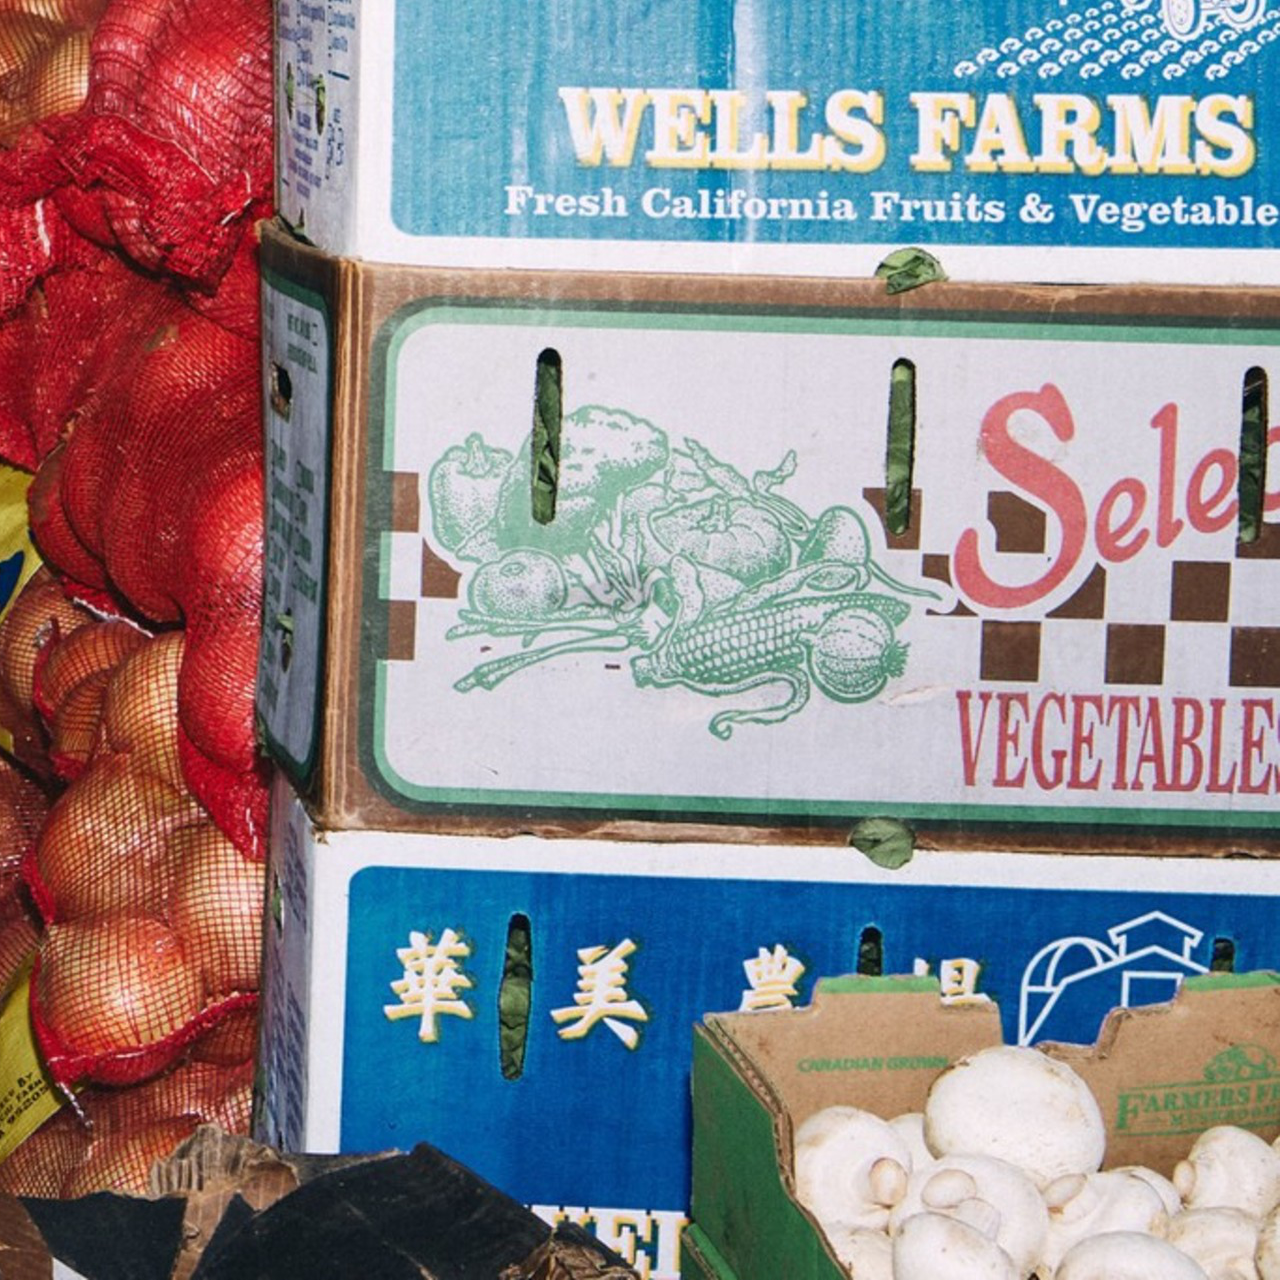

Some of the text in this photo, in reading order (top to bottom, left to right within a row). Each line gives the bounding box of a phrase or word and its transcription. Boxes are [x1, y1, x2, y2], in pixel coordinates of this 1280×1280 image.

[558, 86, 1257, 178] WELLS FARMS
[504, 186, 1280, 233] Fresh California Fruits & Vegetable
[955, 689, 1280, 796] VEGETABLE
[797, 1057, 884, 1073] CANADIAN
[1116, 1086, 1250, 1129] FARMERS
